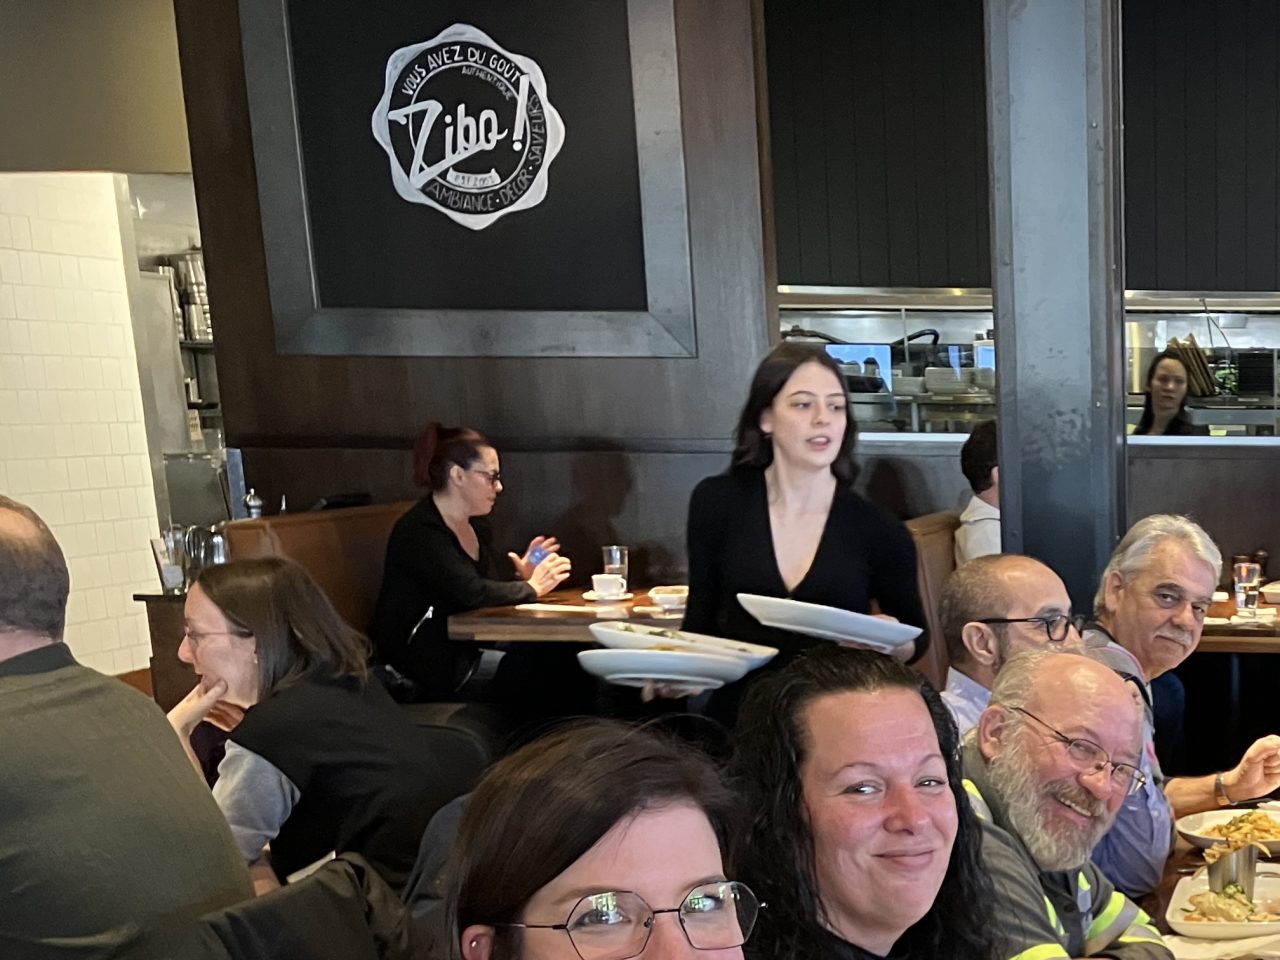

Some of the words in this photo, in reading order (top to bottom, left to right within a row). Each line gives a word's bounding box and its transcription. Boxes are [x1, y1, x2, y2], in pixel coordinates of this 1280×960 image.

[402, 65, 426, 96] VOUS
[427, 45, 464, 69] AVEZ
[467, 47, 486, 64] DU
[426, 182, 495, 211] AMBIANCE
[526, 94, 546, 166] SAVEURS
